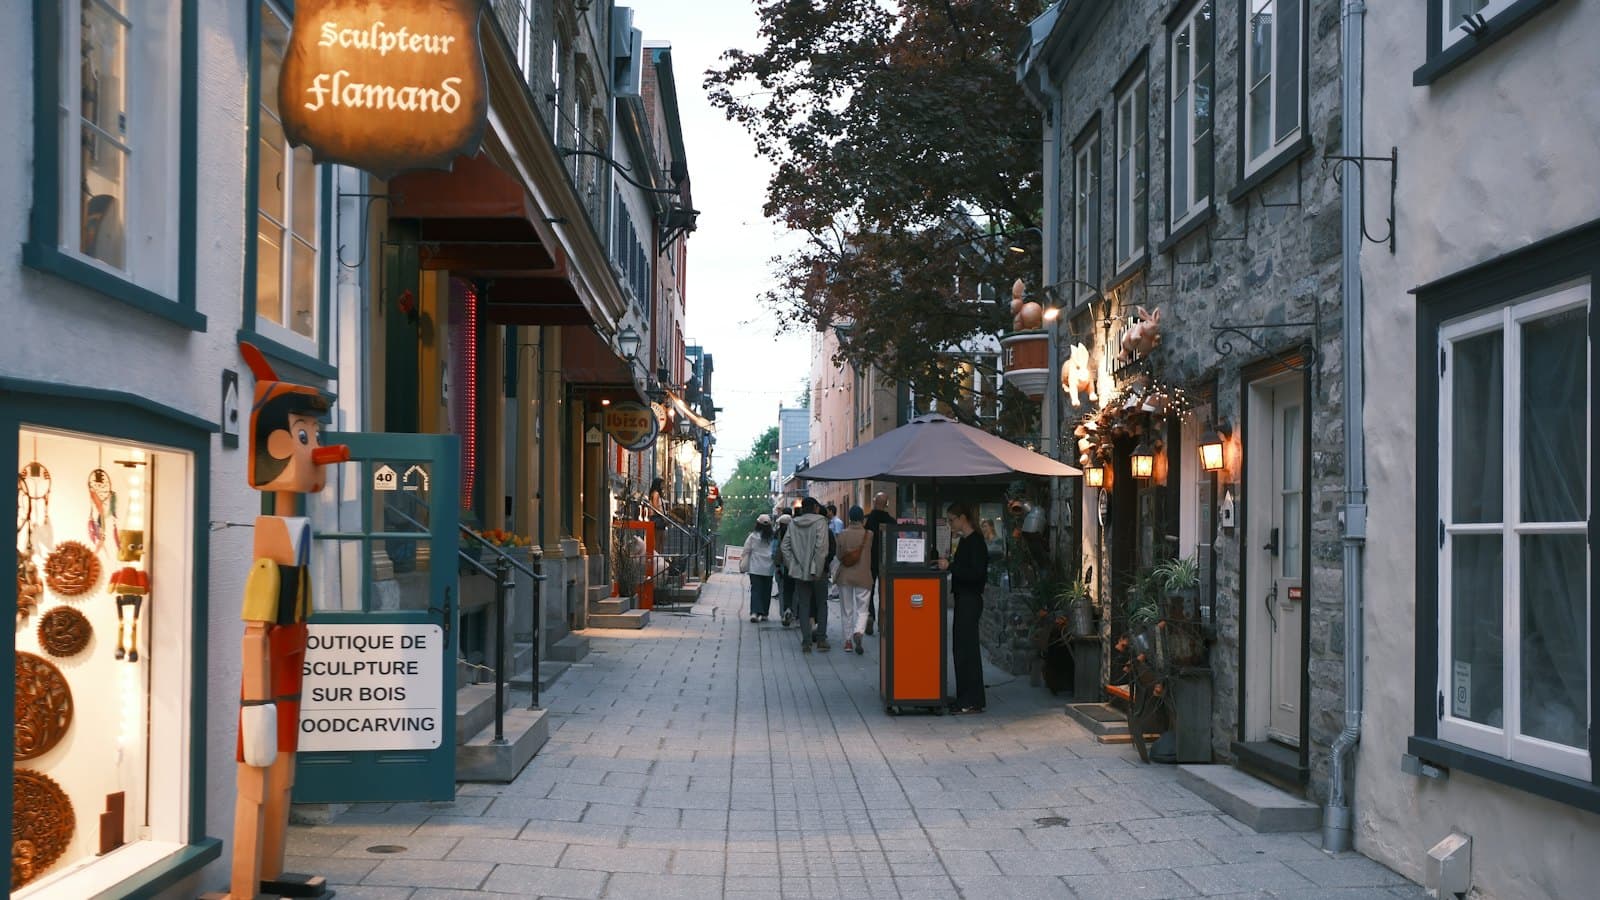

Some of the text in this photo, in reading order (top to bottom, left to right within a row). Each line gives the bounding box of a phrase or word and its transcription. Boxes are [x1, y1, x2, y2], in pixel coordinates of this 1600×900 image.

[318, 21, 456, 56] Sculpteur
[304, 70, 463, 114] Flamand
[606, 412, 648, 428] Ibiza
[376, 473, 392, 482] 40
[306, 635, 427, 653] OUTIQUE DE
[302, 661, 419, 676] SCULPTURE
[311, 687, 406, 702] SUR BOIS
[299, 717, 435, 733] OODCARVING
